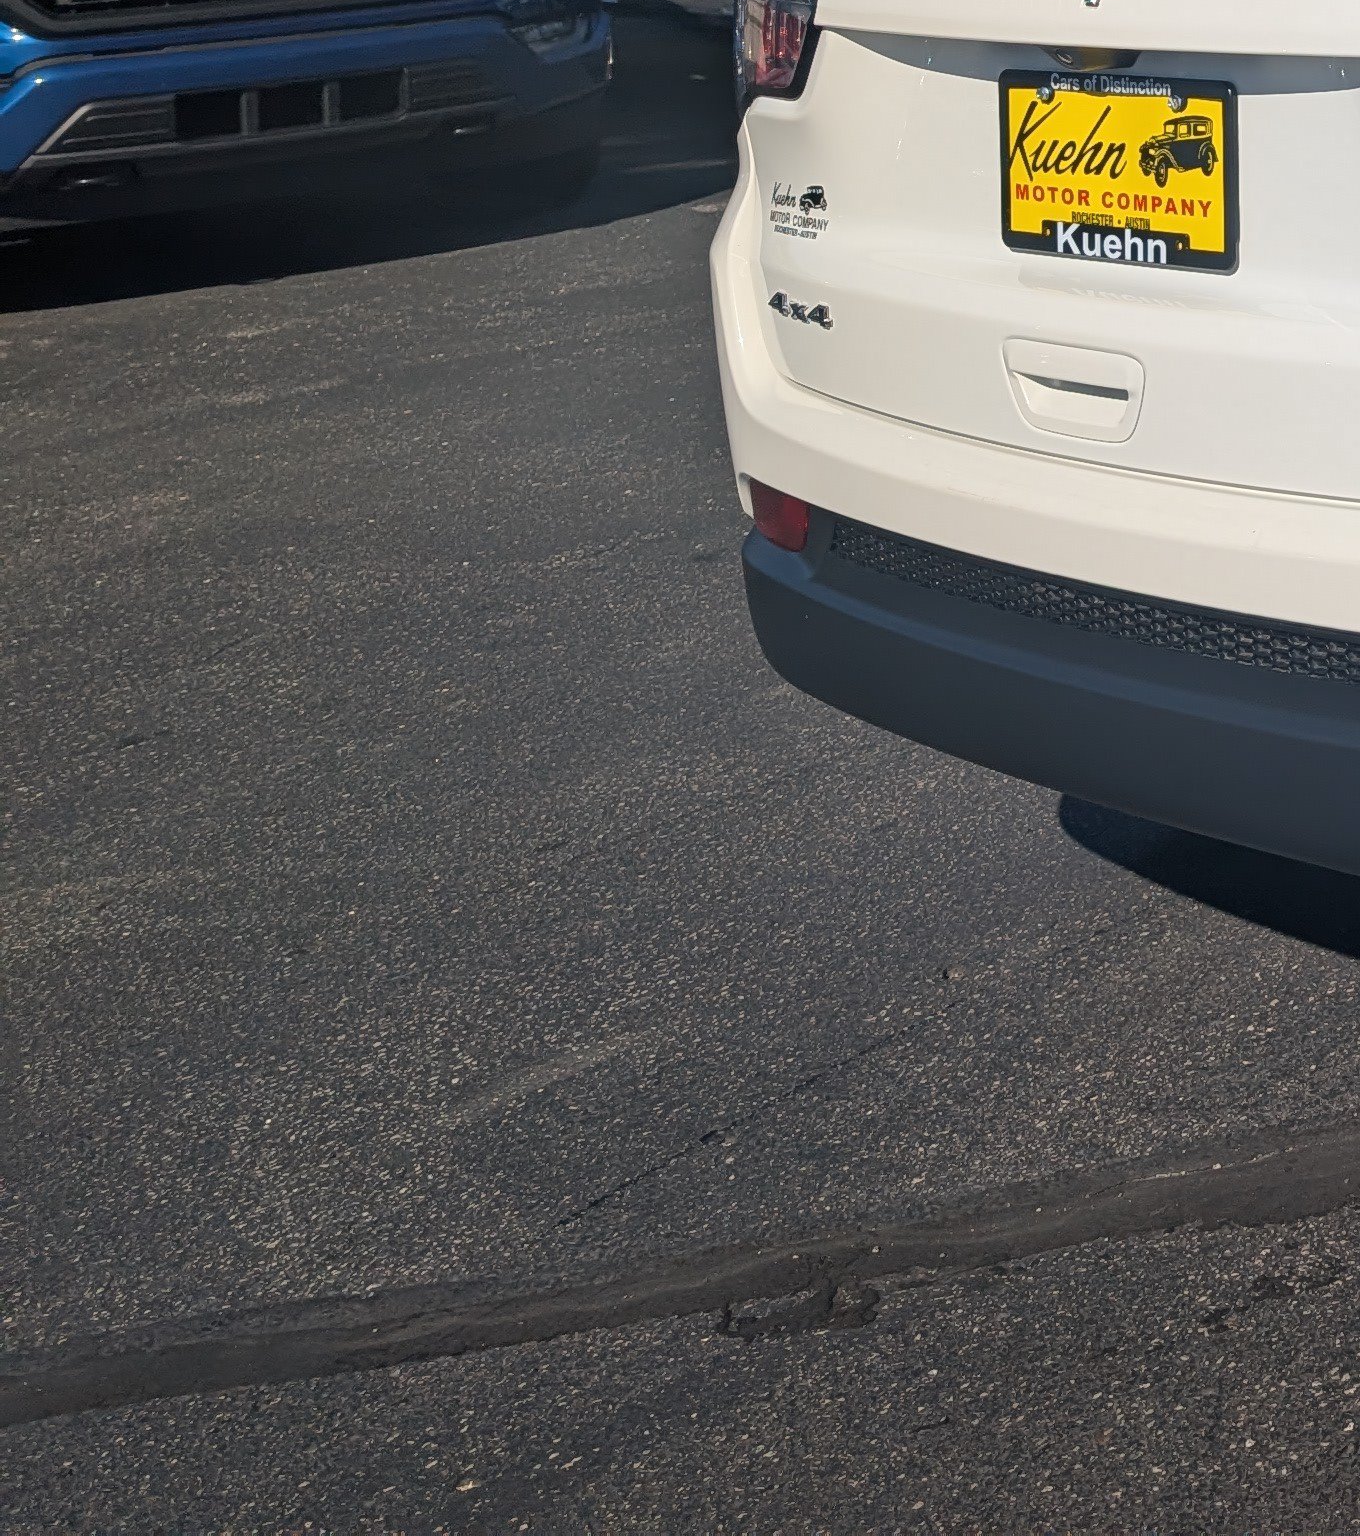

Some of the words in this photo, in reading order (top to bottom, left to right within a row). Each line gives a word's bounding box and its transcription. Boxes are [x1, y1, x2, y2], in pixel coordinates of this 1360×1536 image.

[1051, 72, 1080, 91] Cars
[1083, 75, 1097, 92] of
[1100, 76, 1171, 96] Distinction
[1009, 100, 1128, 182] Kuehn
[771, 181, 797, 208] Kuehn
[1015, 183, 1091, 207] MOTOR
[1101, 191, 1212, 218] COMPANY
[769, 210, 791, 225] MOTOR
[792, 214, 829, 232] COMPANY
[1071, 211, 1114, 227] ROCHESTER
[1125, 216, 1151, 230] AUSTIN
[1056, 221, 1167, 264] Kuehn
